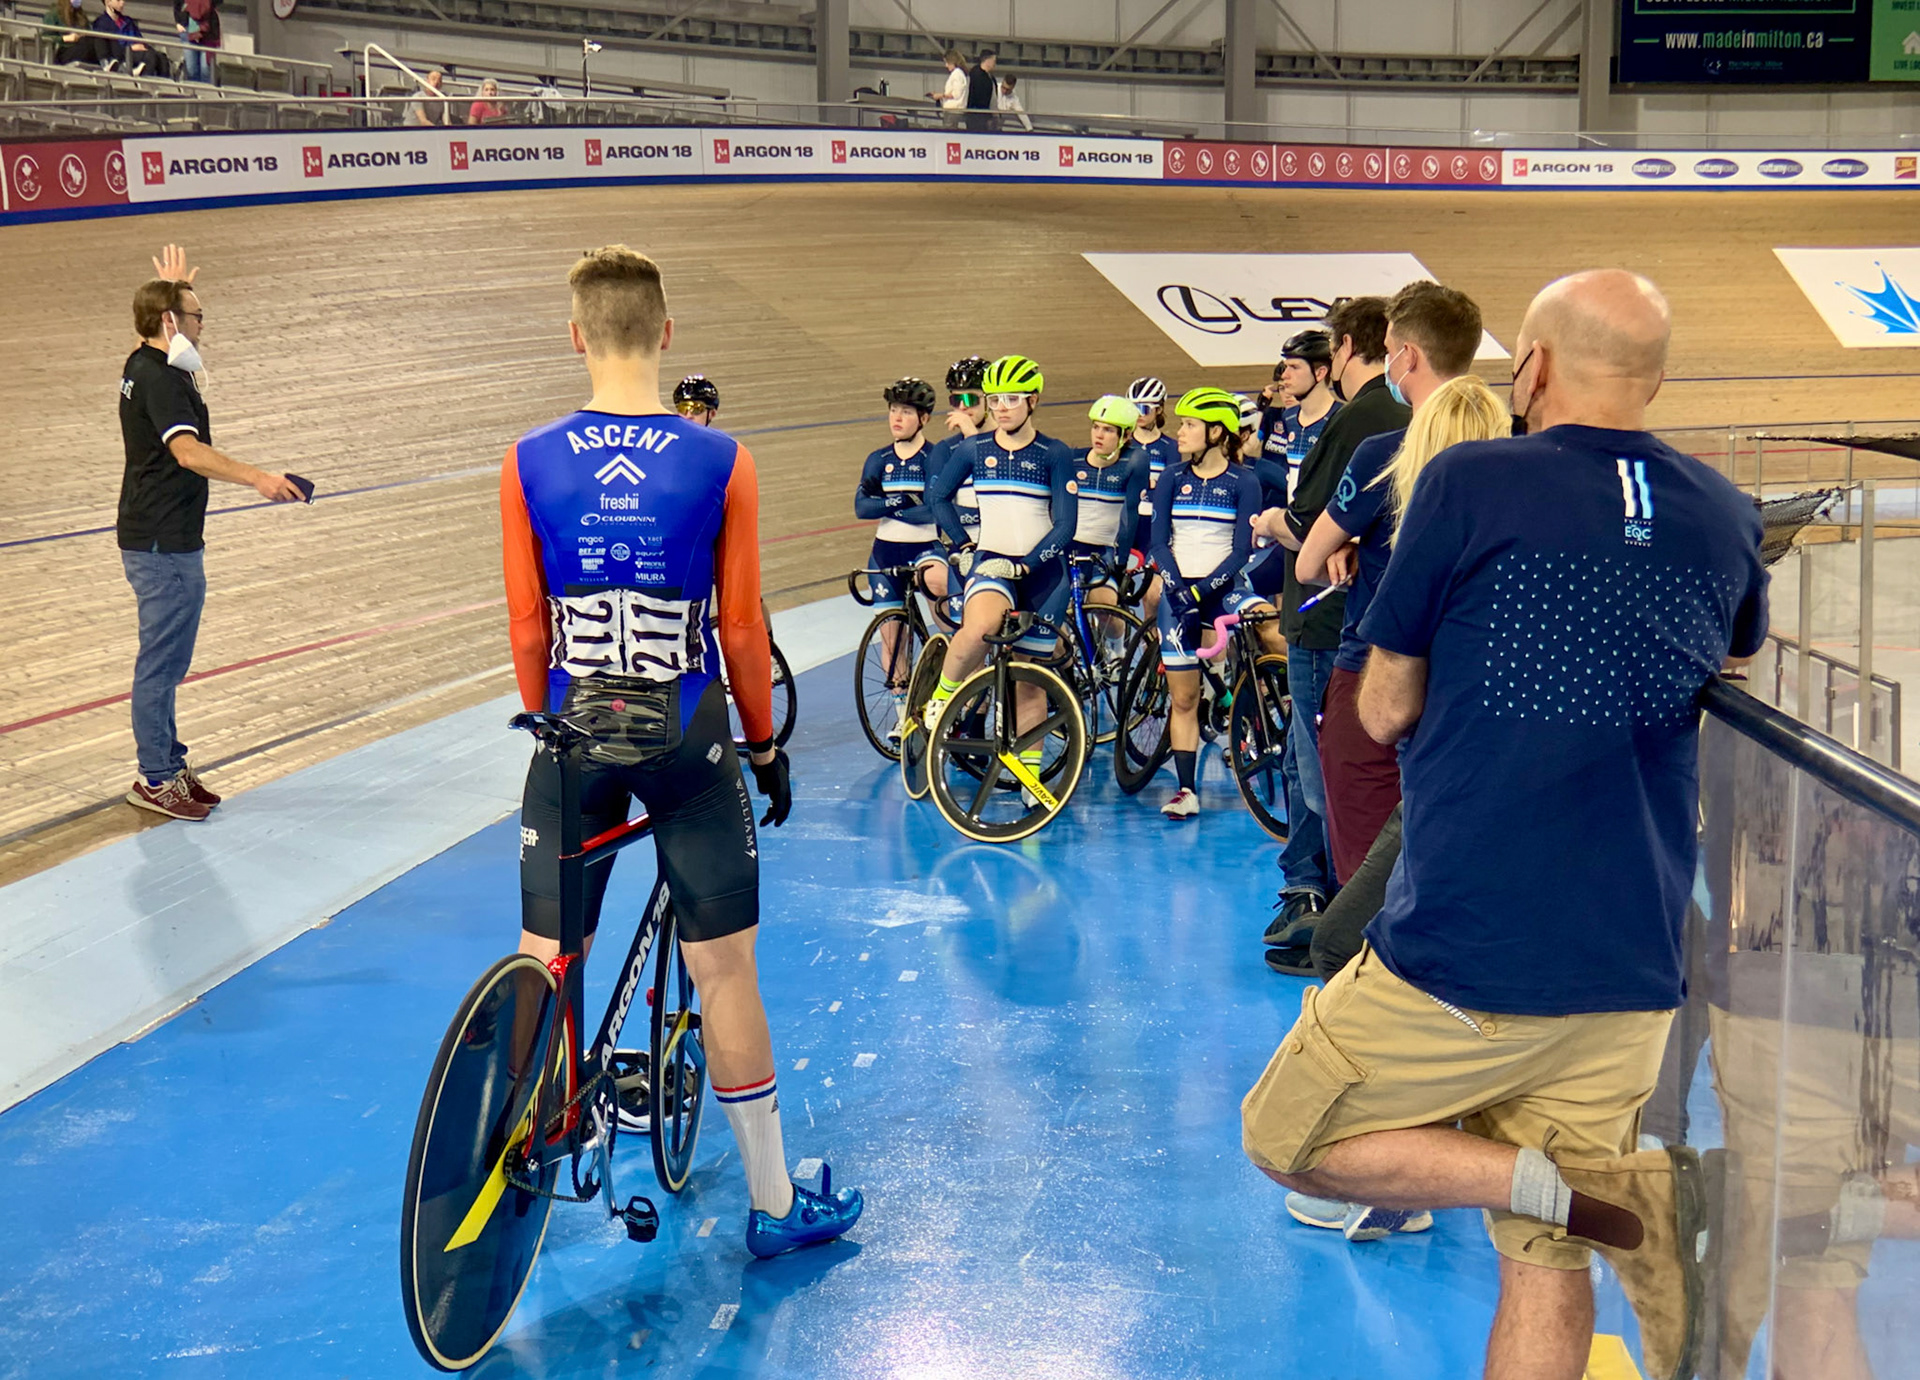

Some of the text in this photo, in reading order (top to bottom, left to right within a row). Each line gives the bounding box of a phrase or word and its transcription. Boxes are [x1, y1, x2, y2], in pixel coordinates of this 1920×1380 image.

[1665, 29, 1823, 49] www.madeinmilton.ca
[327, 150, 428, 168] ARGON 18
[472, 146, 565, 163] ARGON 18
[605, 145, 692, 159] ARGON 18
[733, 145, 814, 158] ARGON 18
[849, 146, 927, 159] ARGON 18
[964, 148, 1040, 161] ARGON 18
[1076, 151, 1153, 164] ARGON 18
[169, 156, 278, 176] ARGON 18
[1531, 163, 1613, 174] ARGON 18
[566, 424, 680, 455] ASCENT
[600, 493, 639, 510] freshii
[601, 515, 656, 523] CLOUDNINE
[635, 572, 666, 581] MIURA
[735, 778, 755, 849] WILLIAM
[601, 881, 672, 1071] ARGON 18
